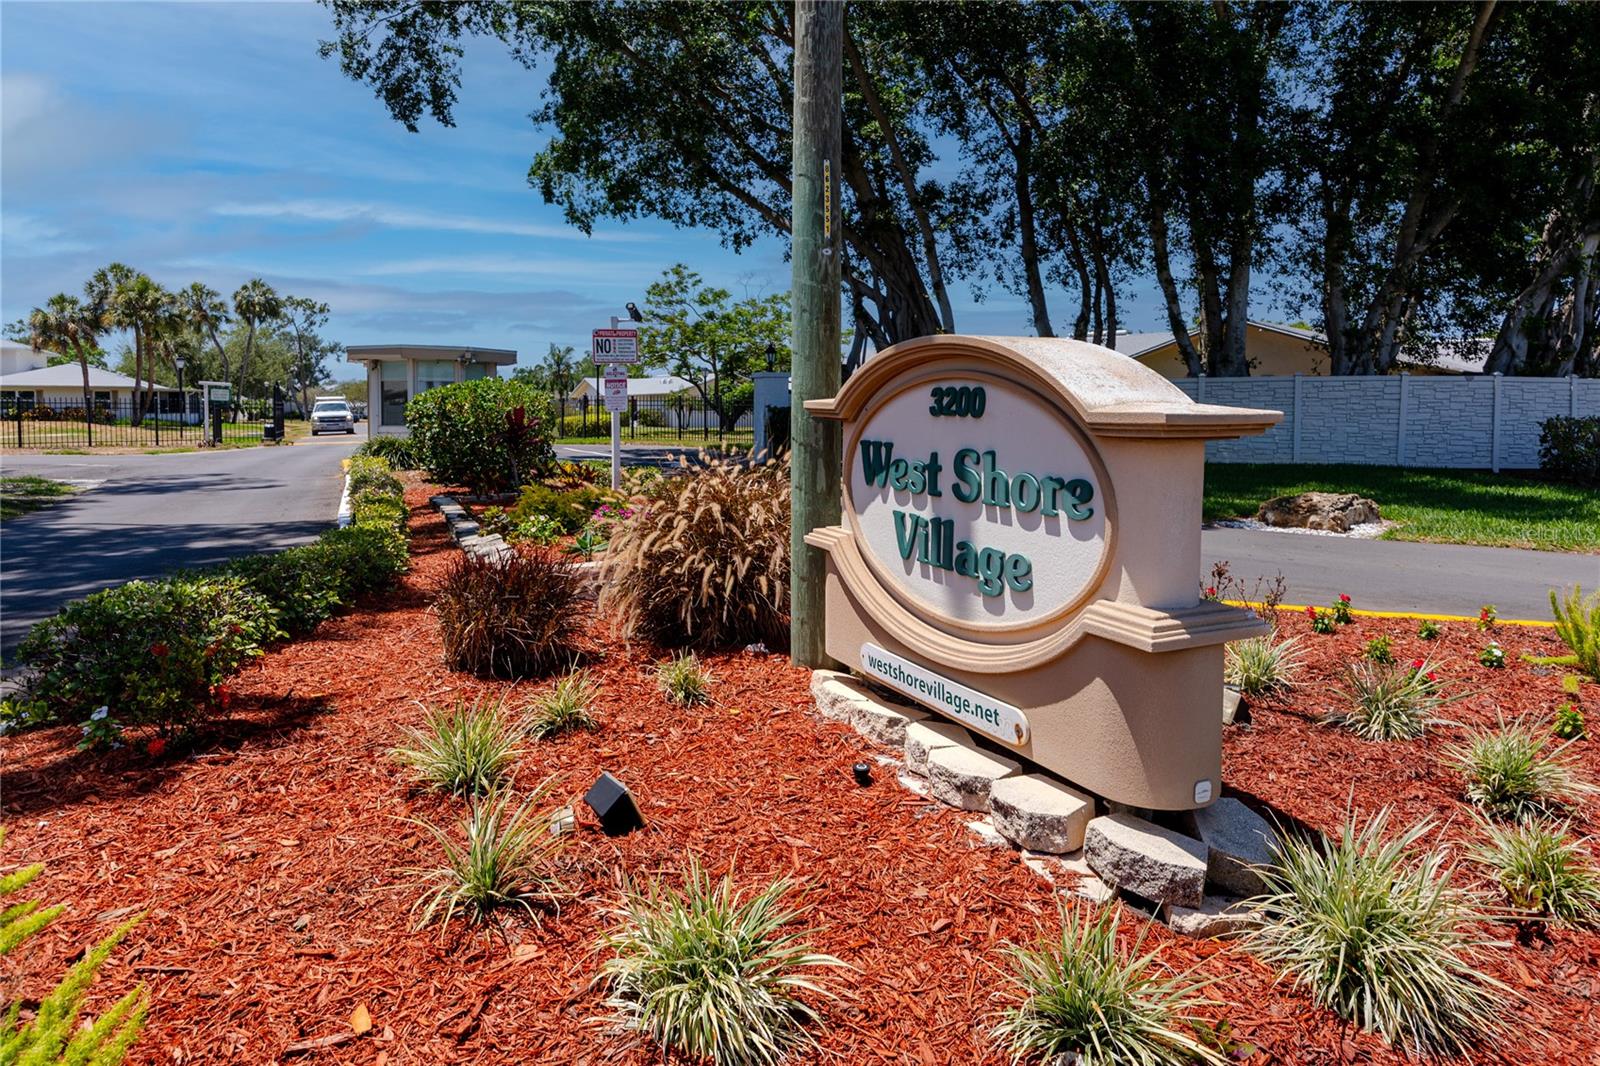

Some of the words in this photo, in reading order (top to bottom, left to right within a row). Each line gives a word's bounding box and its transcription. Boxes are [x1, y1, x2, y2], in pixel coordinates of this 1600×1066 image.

[596, 338, 611, 353] NO
[928, 386, 987, 419] 3200
[859, 439, 943, 498] West
[951, 447, 1095, 522] Shore
[892, 510, 1034, 598] Village
[867, 653, 1000, 727] westshorevillage.net
